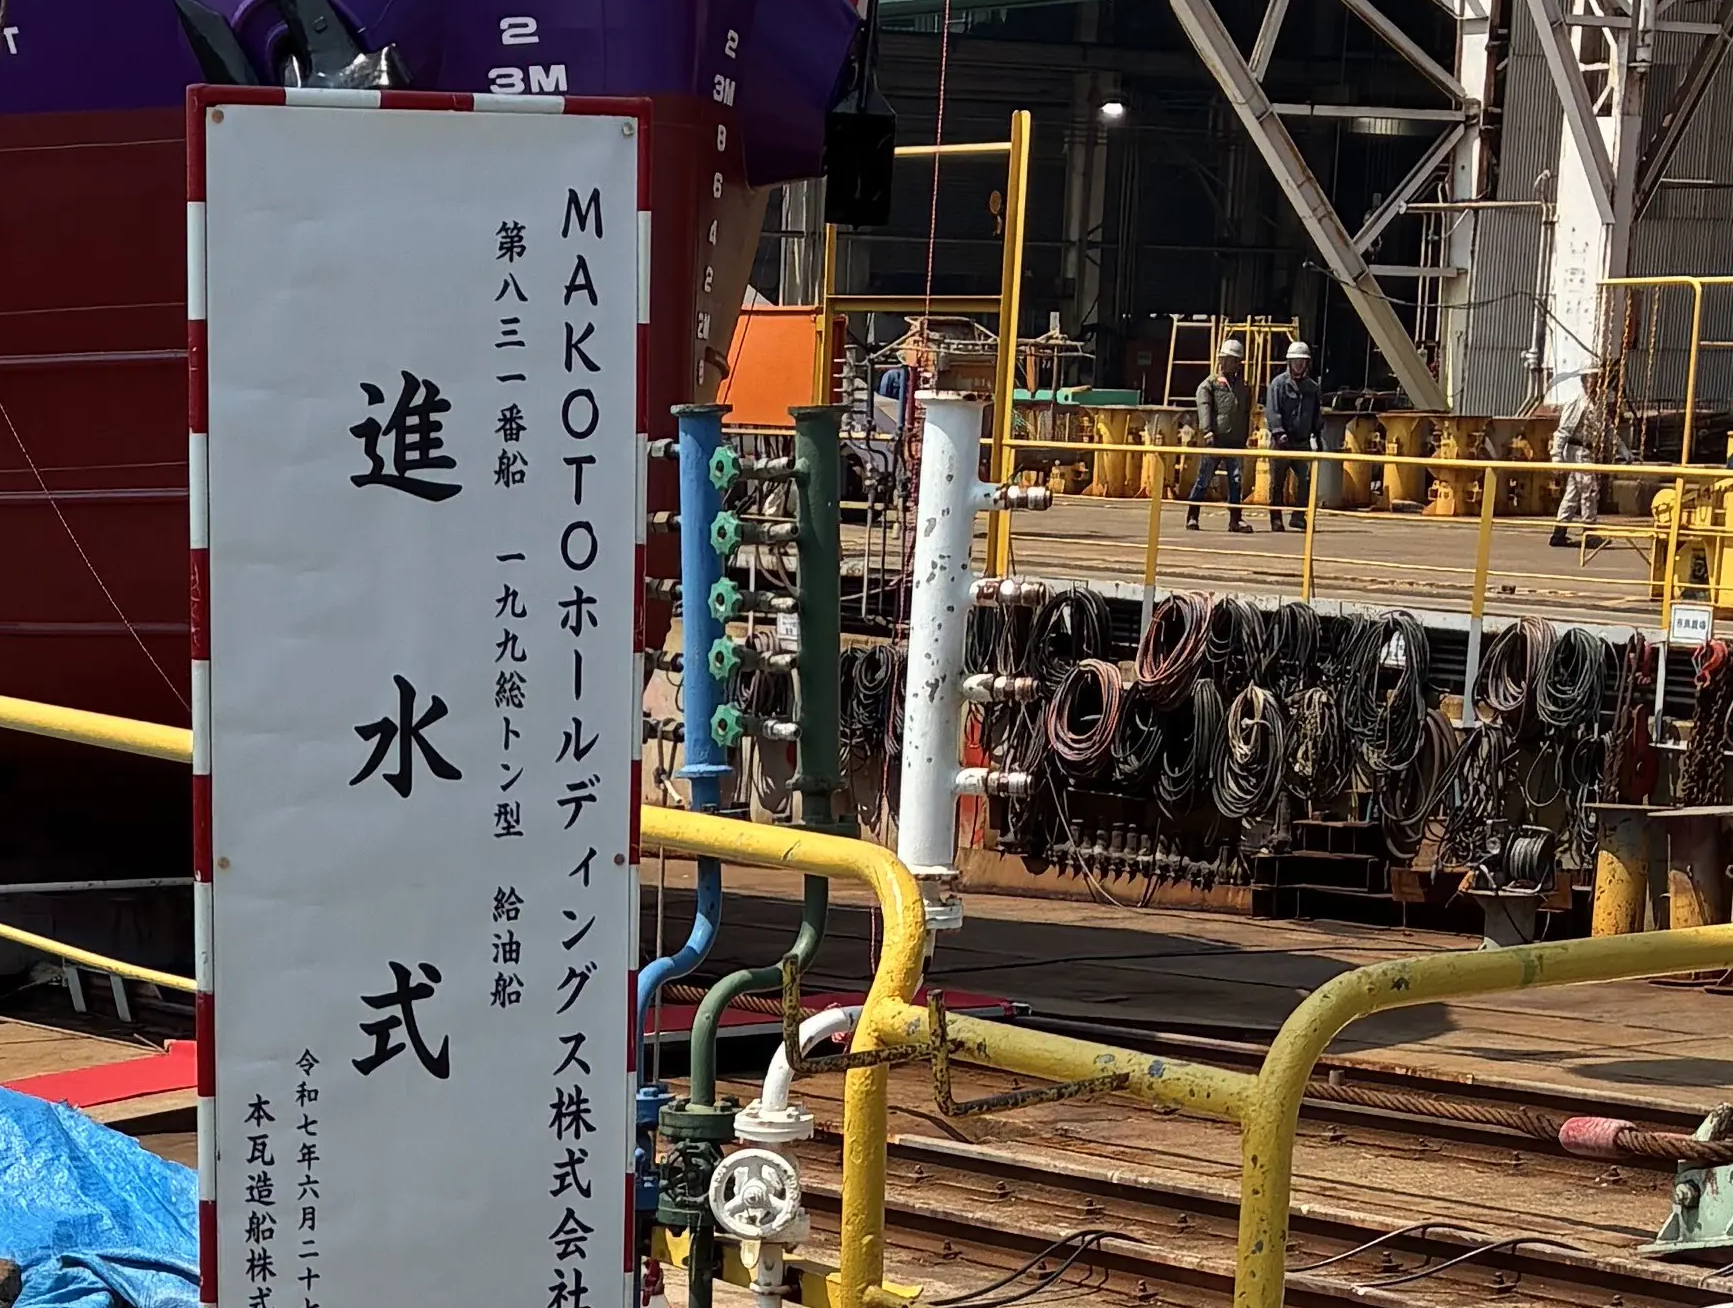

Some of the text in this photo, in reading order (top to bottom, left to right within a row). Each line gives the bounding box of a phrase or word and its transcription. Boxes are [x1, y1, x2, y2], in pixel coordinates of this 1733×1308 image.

[499, 16, 540, 45] 2
[725, 29, 739, 59] 2
[488, 64, 567, 94] 3M
[713, 74, 736, 107] 3M
[490, 220, 529, 1009] 第八三一番船 一九九総トン型 給油船
[348, 370, 463, 1080] 進水式
